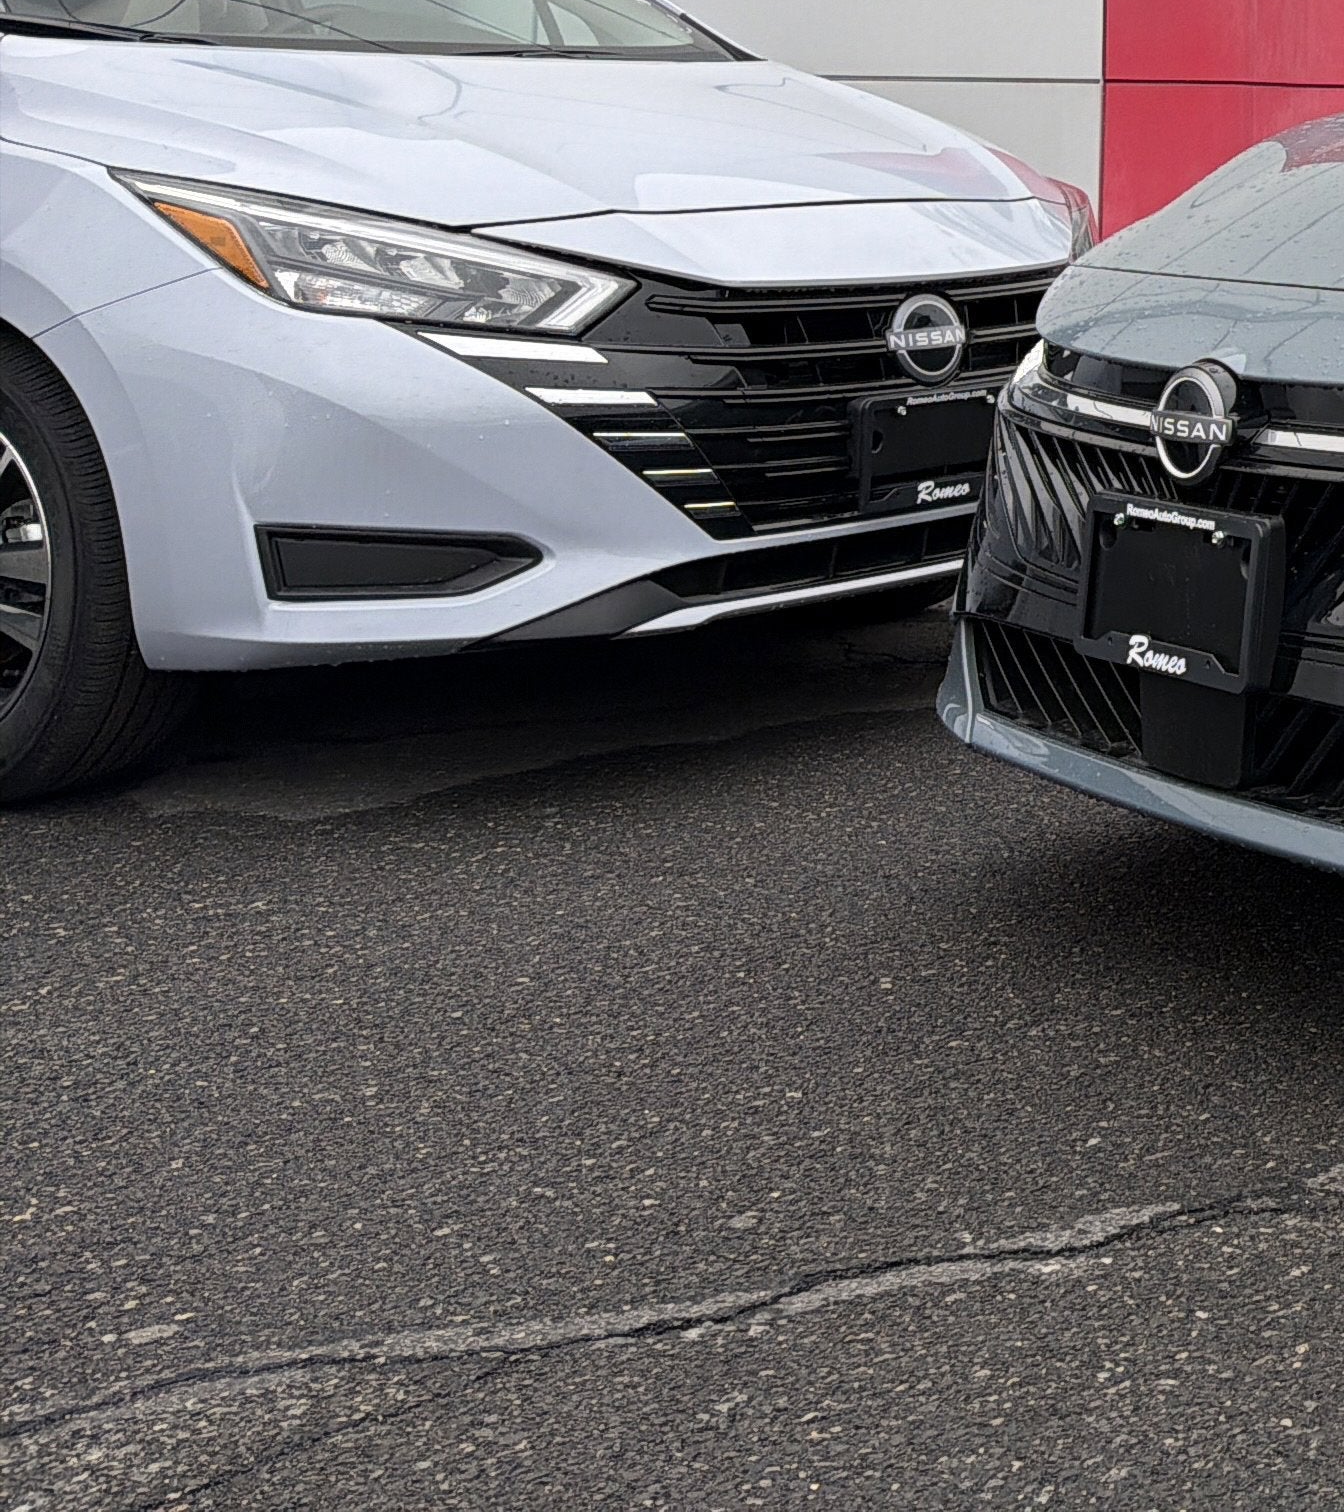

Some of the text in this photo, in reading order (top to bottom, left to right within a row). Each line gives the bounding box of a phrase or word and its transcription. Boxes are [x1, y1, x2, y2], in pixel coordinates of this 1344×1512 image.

[889, 327, 966, 349] NISSAN
[1151, 414, 1227, 441] NISSAN
[916, 480, 971, 505] Romeo
[1126, 503, 1216, 530] RomeoAutoGroup.com
[1126, 634, 1187, 675] Romeo
